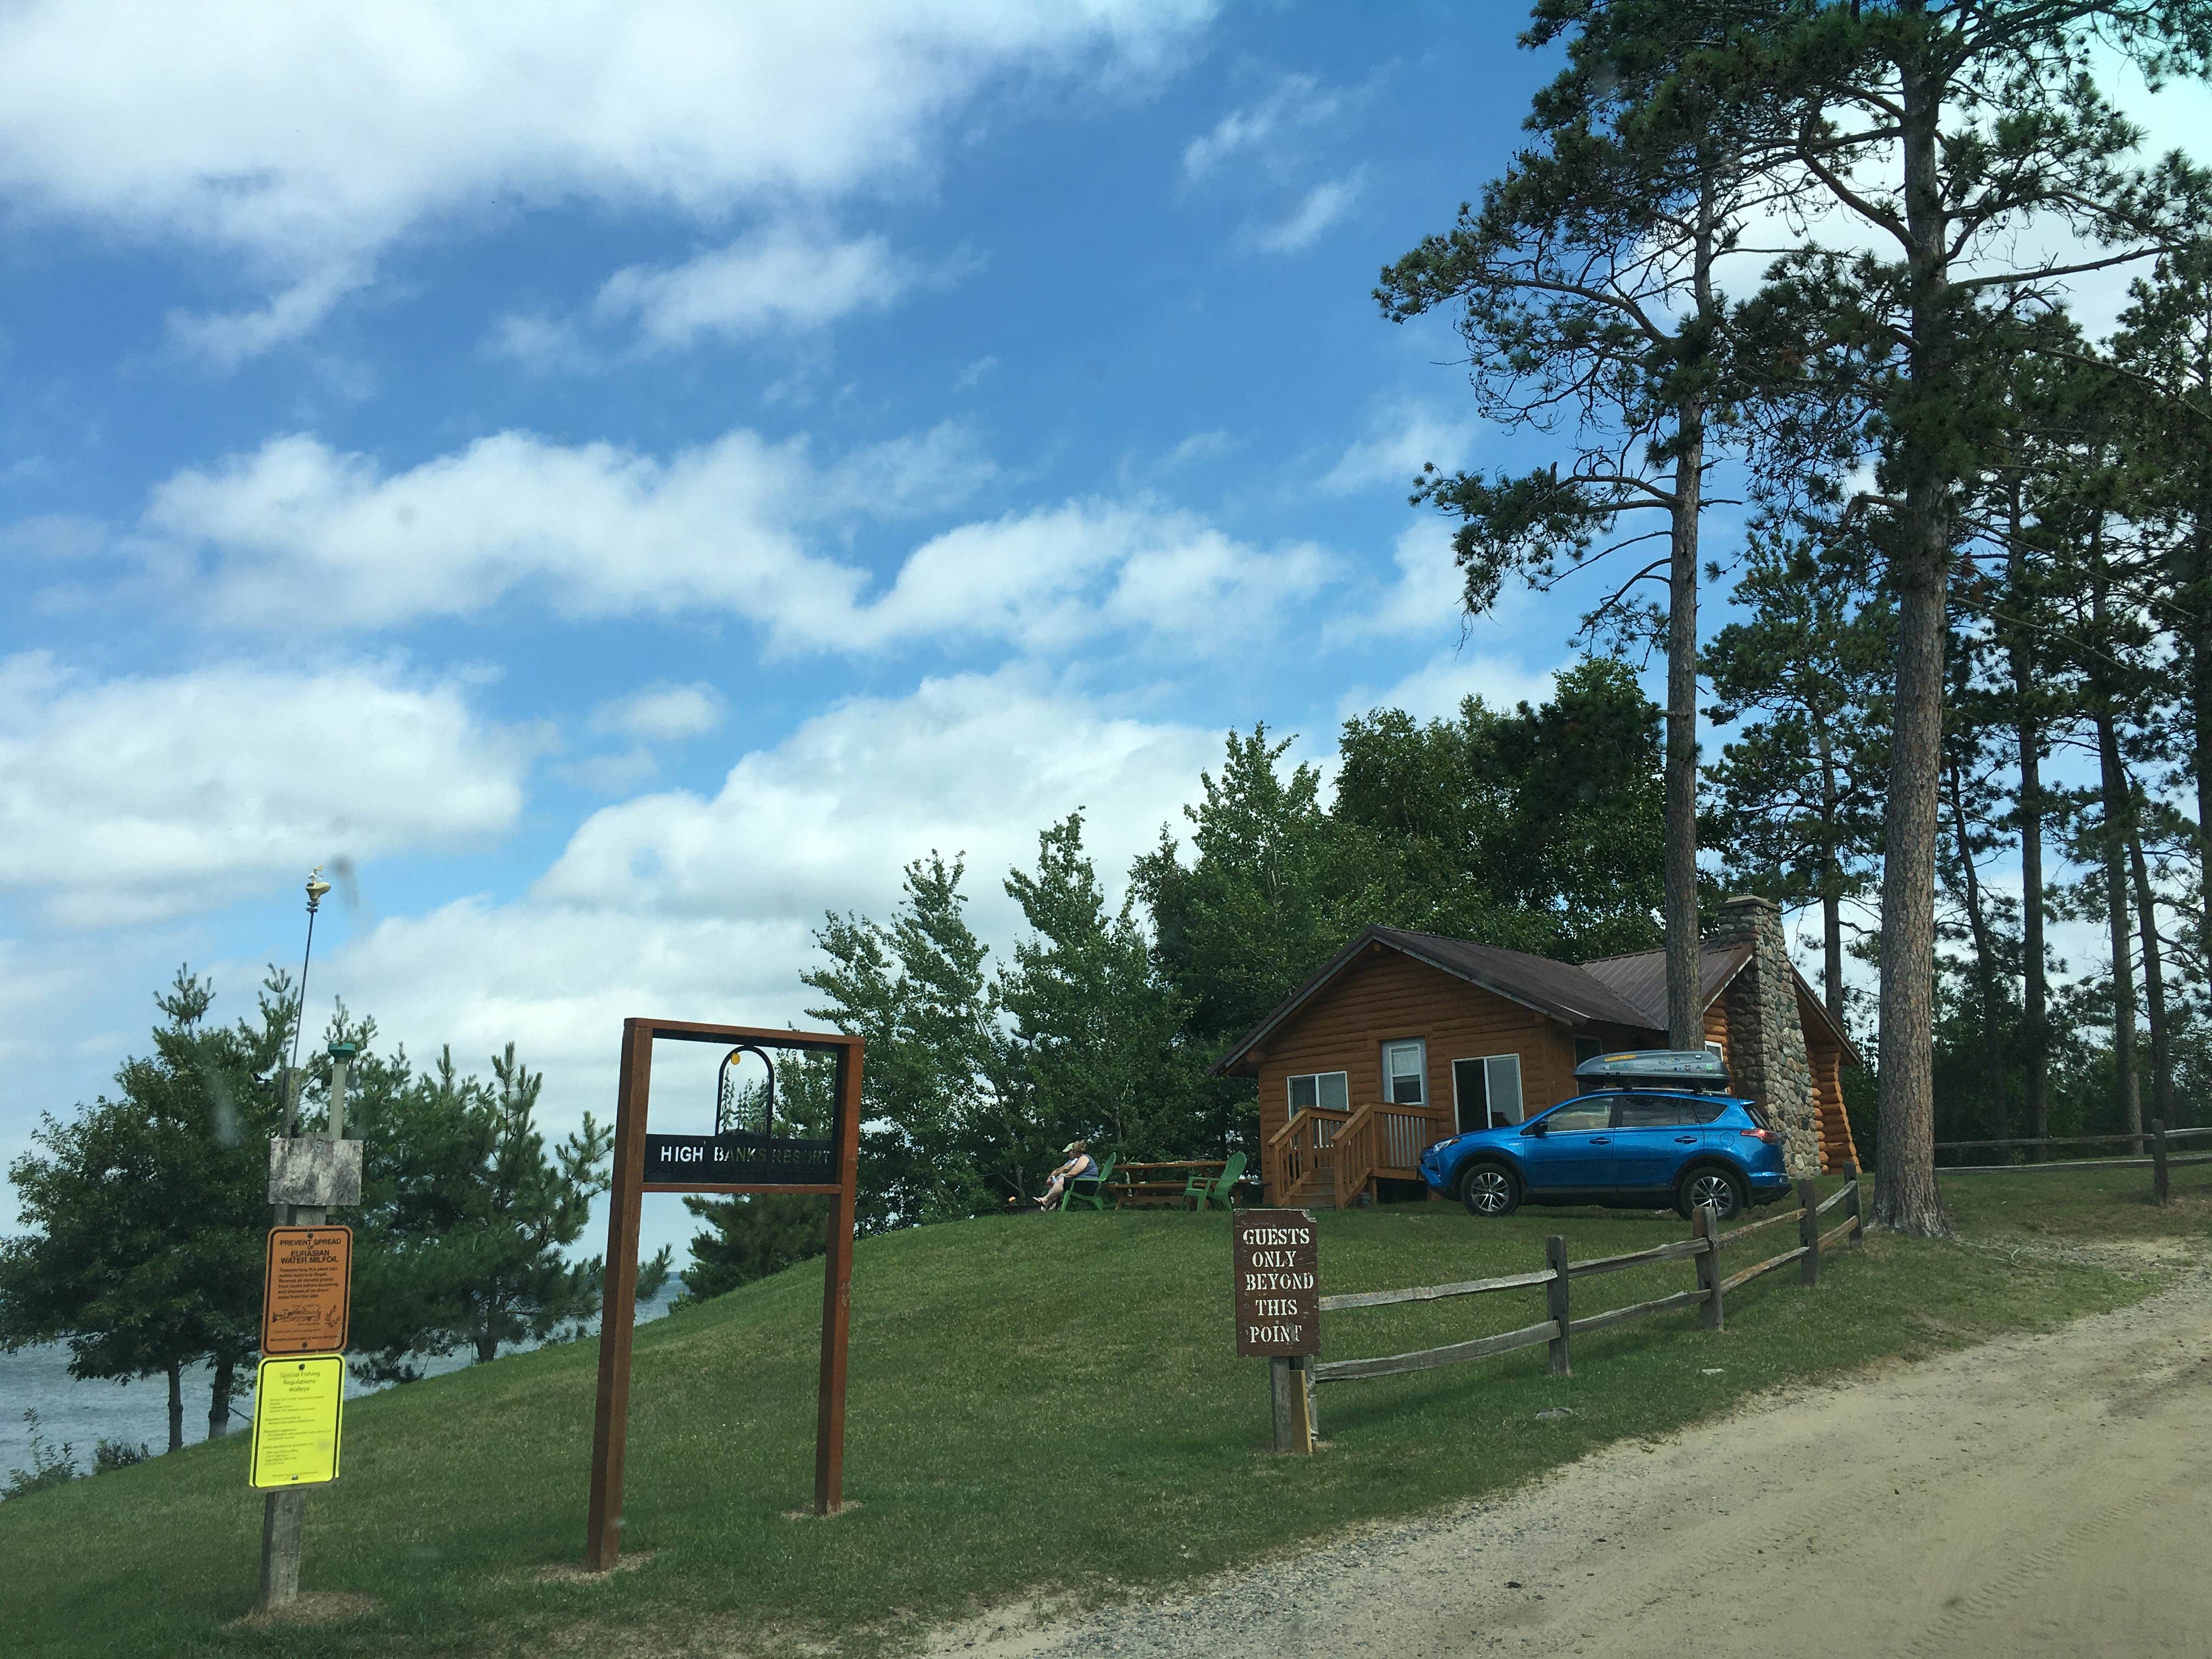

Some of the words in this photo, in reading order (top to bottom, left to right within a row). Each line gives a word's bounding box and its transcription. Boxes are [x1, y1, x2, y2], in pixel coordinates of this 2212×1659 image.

[661, 1146, 703, 1162] HIGH
[714, 1147, 766, 1163] BANKS
[1243, 1228, 1310, 1245] GUESTS
[1252, 1251, 1296, 1267] ONLY
[1245, 1272, 1314, 1290] BEYOND
[1255, 1299, 1297, 1316] THIS
[1250, 1325, 1302, 1343] POINT
